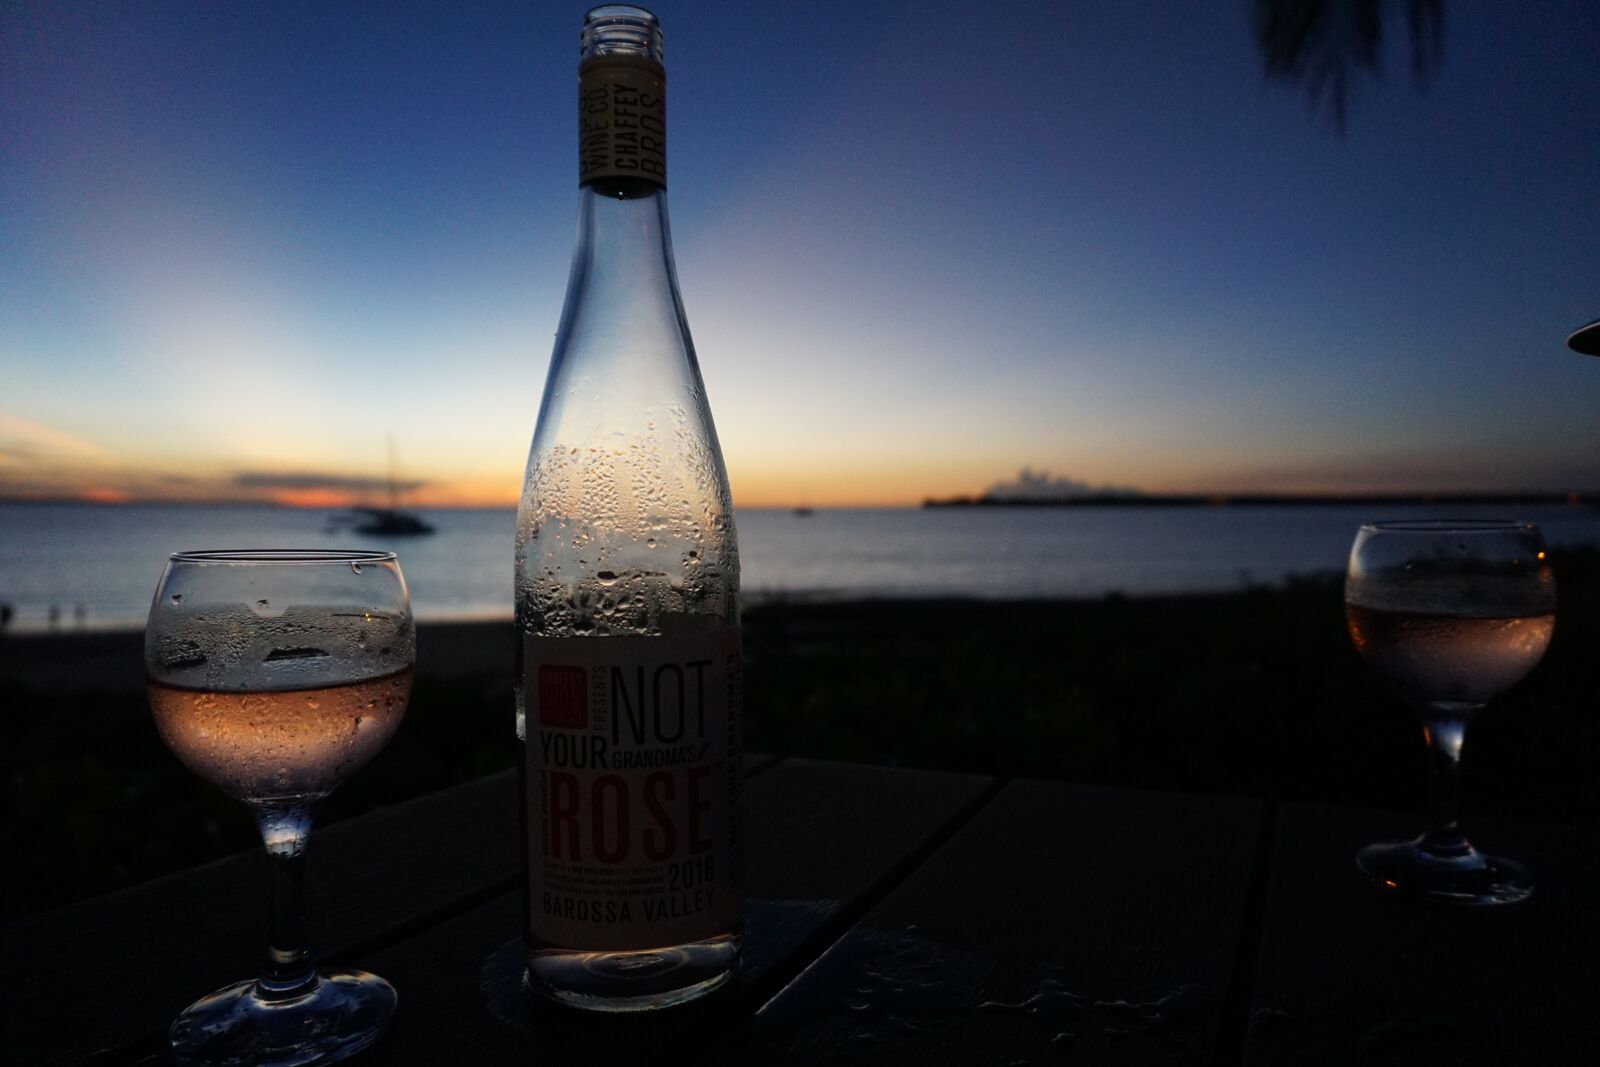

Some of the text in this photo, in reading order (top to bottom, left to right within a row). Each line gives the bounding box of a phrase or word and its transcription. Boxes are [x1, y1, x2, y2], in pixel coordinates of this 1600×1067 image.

[589, 119, 608, 172] WINE
[614, 83, 638, 170] CHAFFEY
[640, 93, 665, 177] BROS
[593, 665, 608, 731] PRESENTS
[611, 660, 713, 746] NOT
[540, 731, 696, 769] YOUR GRANDMA'S
[549, 742, 712, 864] ROSÉ
[543, 887, 715, 922] BAROSSA VALLEY
[668, 855, 714, 891] 2016
